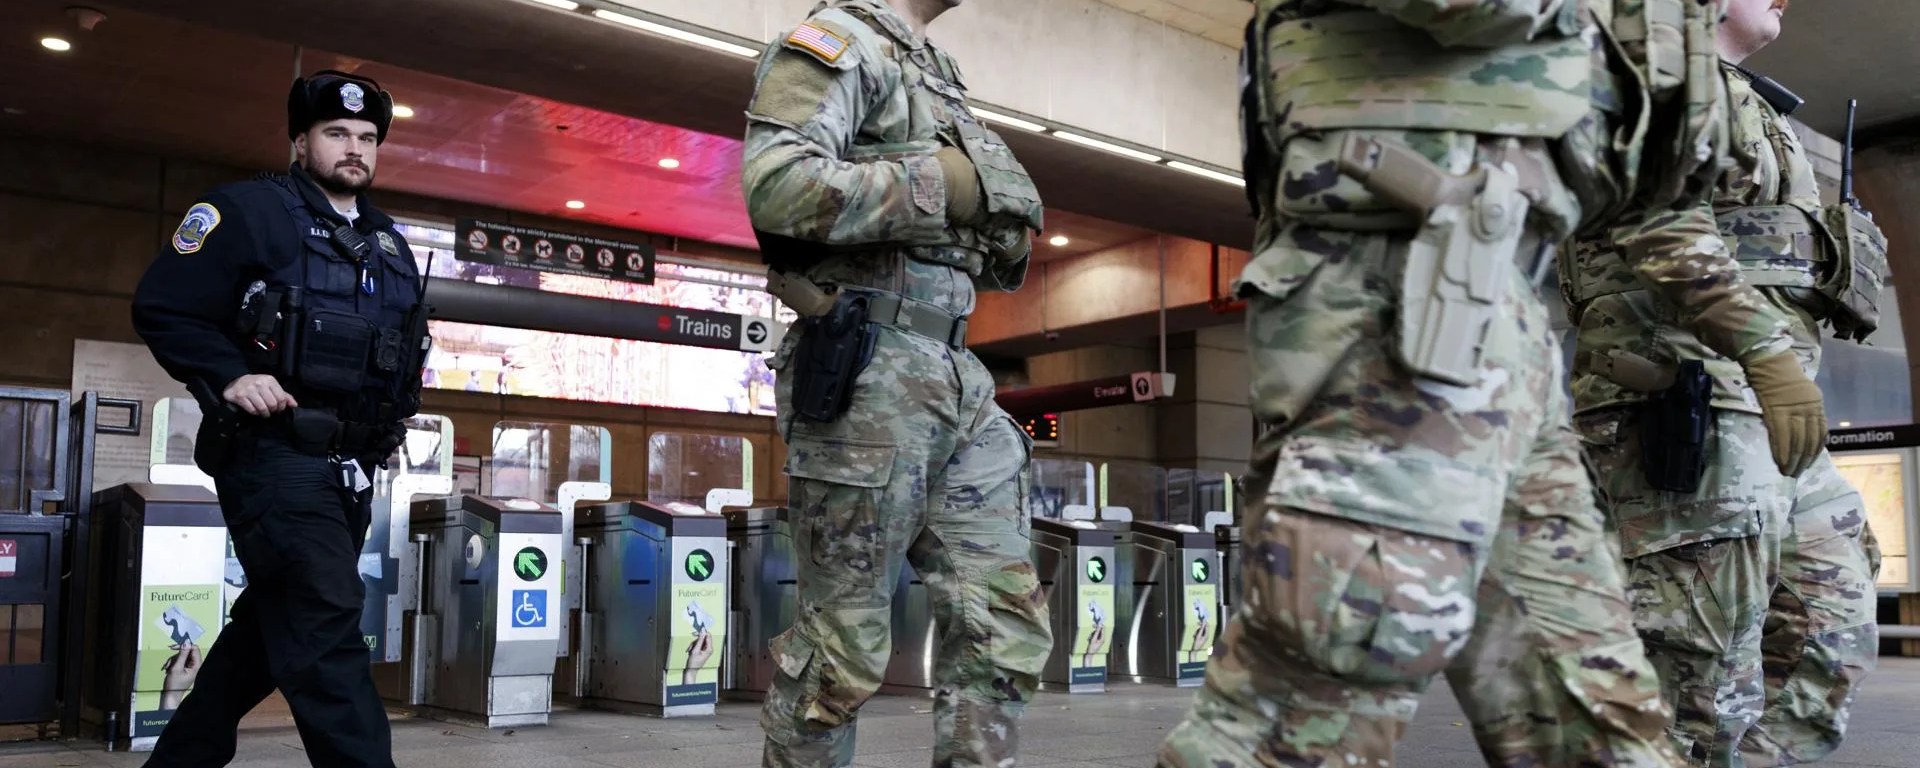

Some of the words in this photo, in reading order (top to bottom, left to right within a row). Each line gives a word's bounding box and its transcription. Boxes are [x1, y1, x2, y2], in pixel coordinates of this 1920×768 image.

[475, 220, 487, 228] The
[488, 222, 515, 233] following
[528, 228, 547, 237] strictly
[548, 231, 577, 242] prohibited
[595, 238, 619, 247] Metrorail
[620, 242, 639, 250] system
[676, 315, 732, 339] Trains
